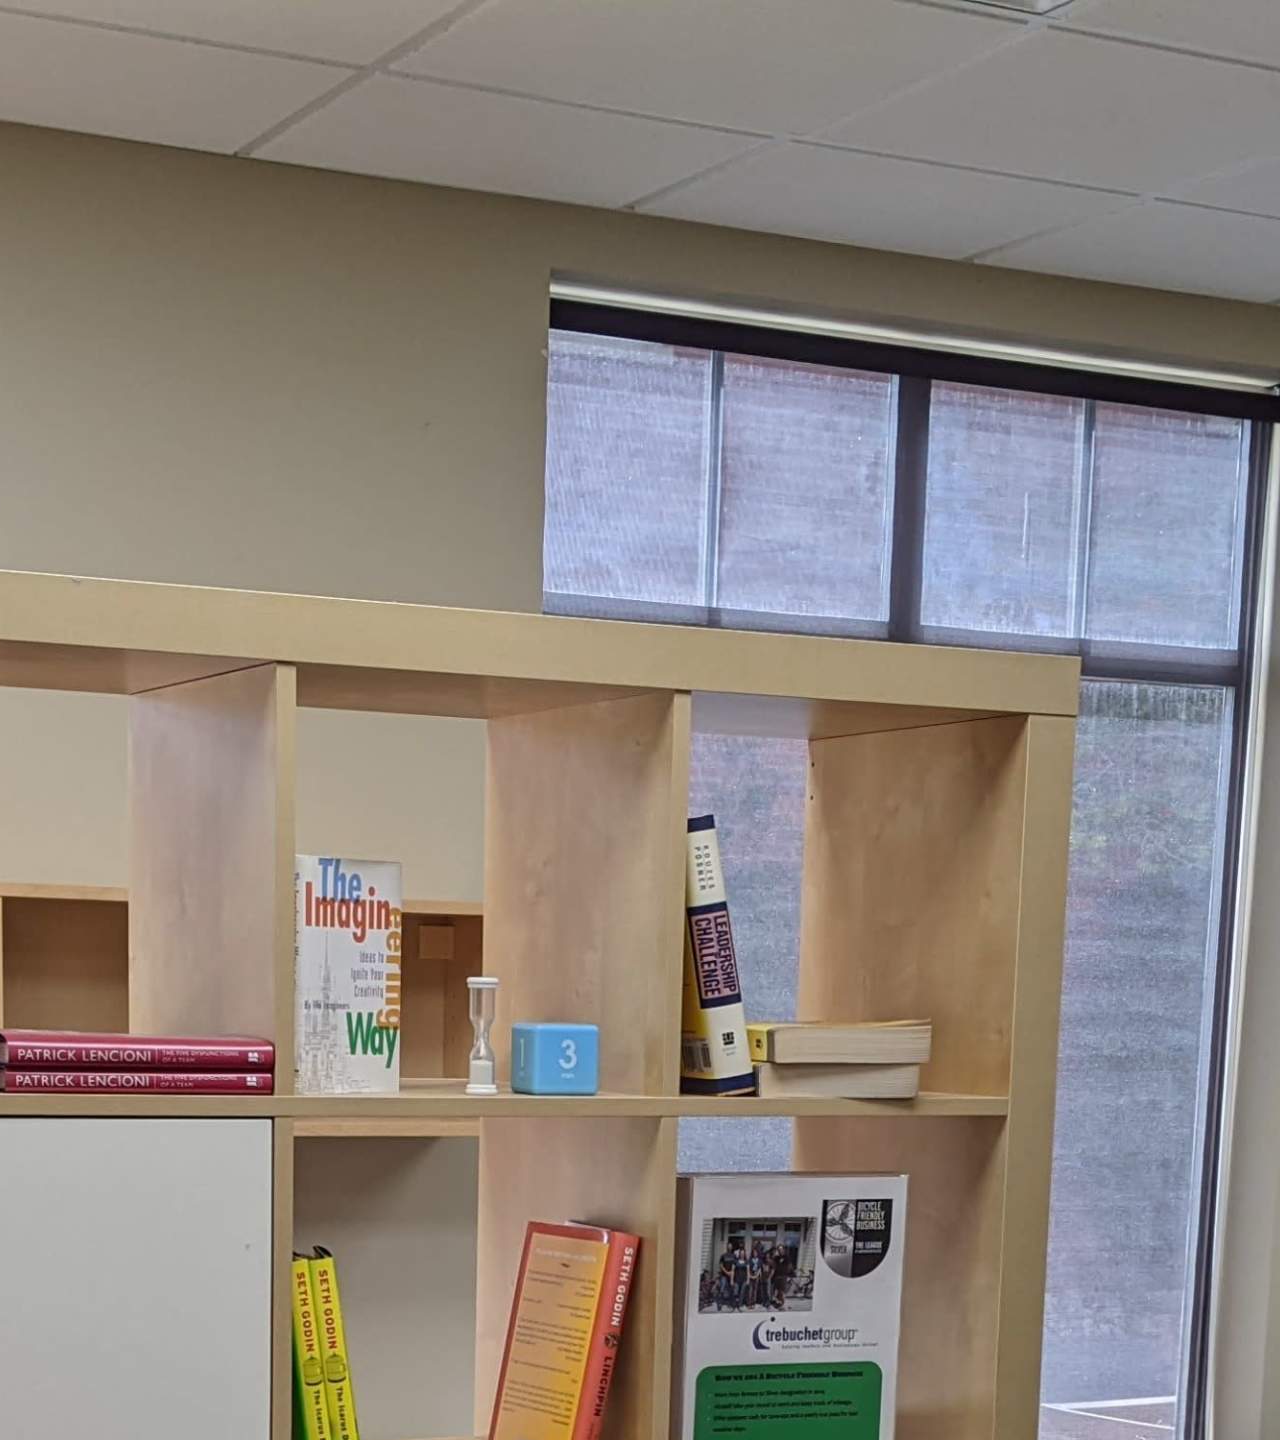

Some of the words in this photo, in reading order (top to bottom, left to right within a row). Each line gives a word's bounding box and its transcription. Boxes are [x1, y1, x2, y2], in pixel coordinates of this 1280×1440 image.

[319, 858, 362, 902] The
[694, 917, 721, 997] CHALLENGE
[713, 914, 737, 993] LEADERSHIP
[17, 1049, 77, 1061] PATRICK
[82, 1050, 151, 1062] LENCIONI
[346, 1012, 398, 1069] Way
[559, 1039, 577, 1069] 3
[16, 1075, 74, 1087] PATRICK
[81, 1075, 149, 1087] LENCIONI
[857, 1220, 885, 1230] BUSINESS
[619, 1247, 634, 1281] SETH
[297, 1272, 309, 1305] SETH
[319, 1270, 331, 1304] SETH
[610, 1285, 627, 1326] GODIN
[301, 1311, 315, 1352] GODIN
[324, 1308, 337, 1350] GODIN
[336, 1387, 344, 1398] The
[593, 1356, 613, 1417] LINCHPIN
